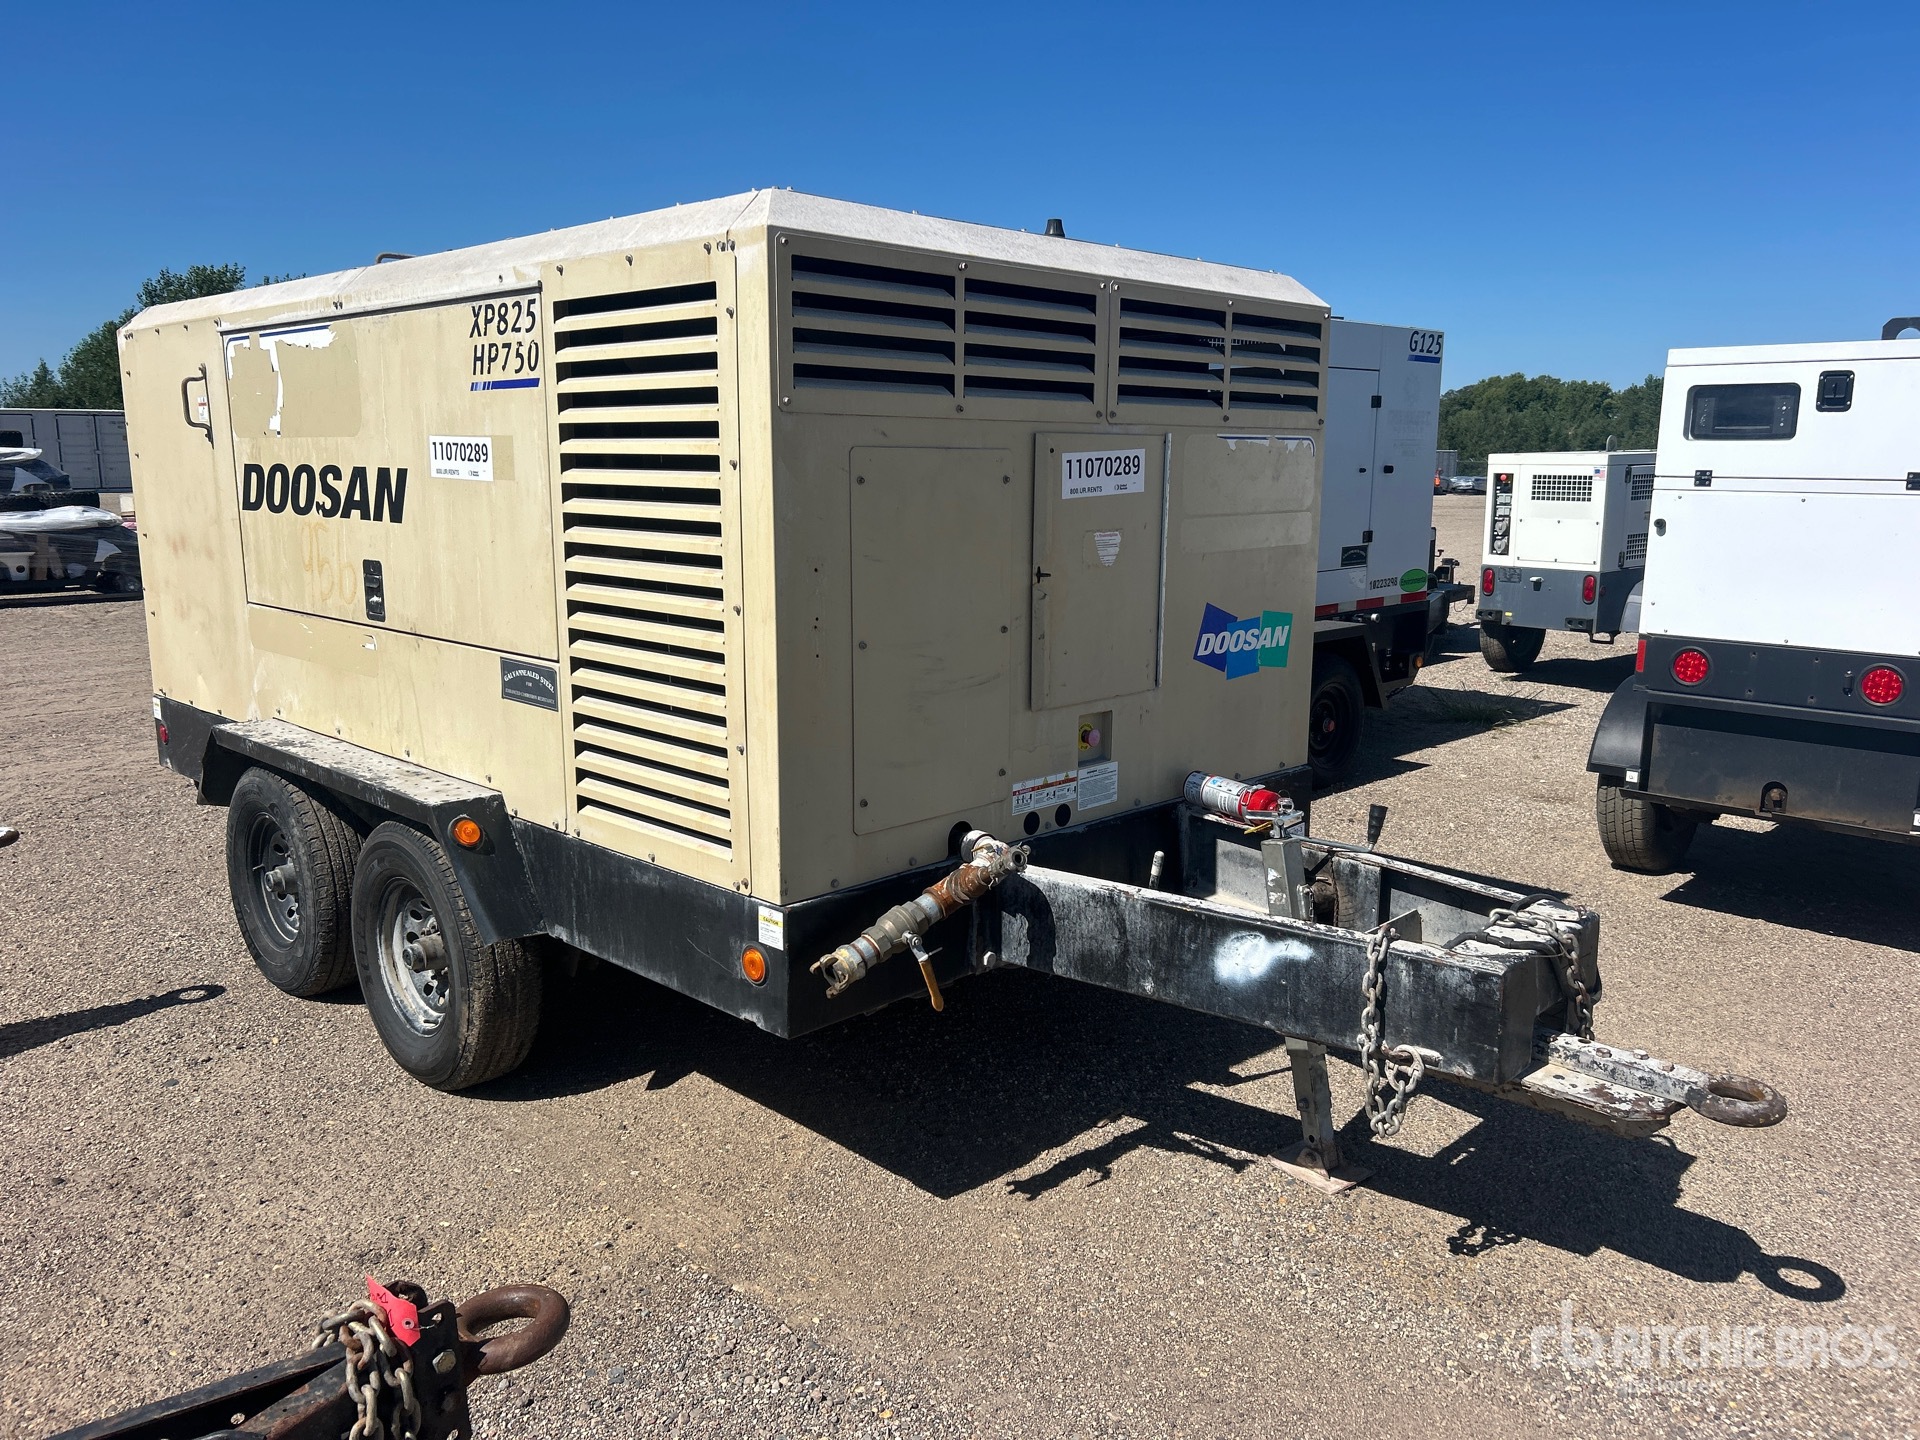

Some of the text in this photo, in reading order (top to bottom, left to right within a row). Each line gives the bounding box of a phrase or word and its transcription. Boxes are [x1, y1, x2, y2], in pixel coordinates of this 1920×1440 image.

[469, 298, 537, 338] XP825
[473, 339, 539, 375] HP750
[1409, 330, 1443, 355] G125
[432, 441, 488, 463] 11070289
[1066, 455, 1141, 479] 11070289
[242, 463, 408, 524] DOOSAN
[1197, 625, 1290, 656] DOOSAN
